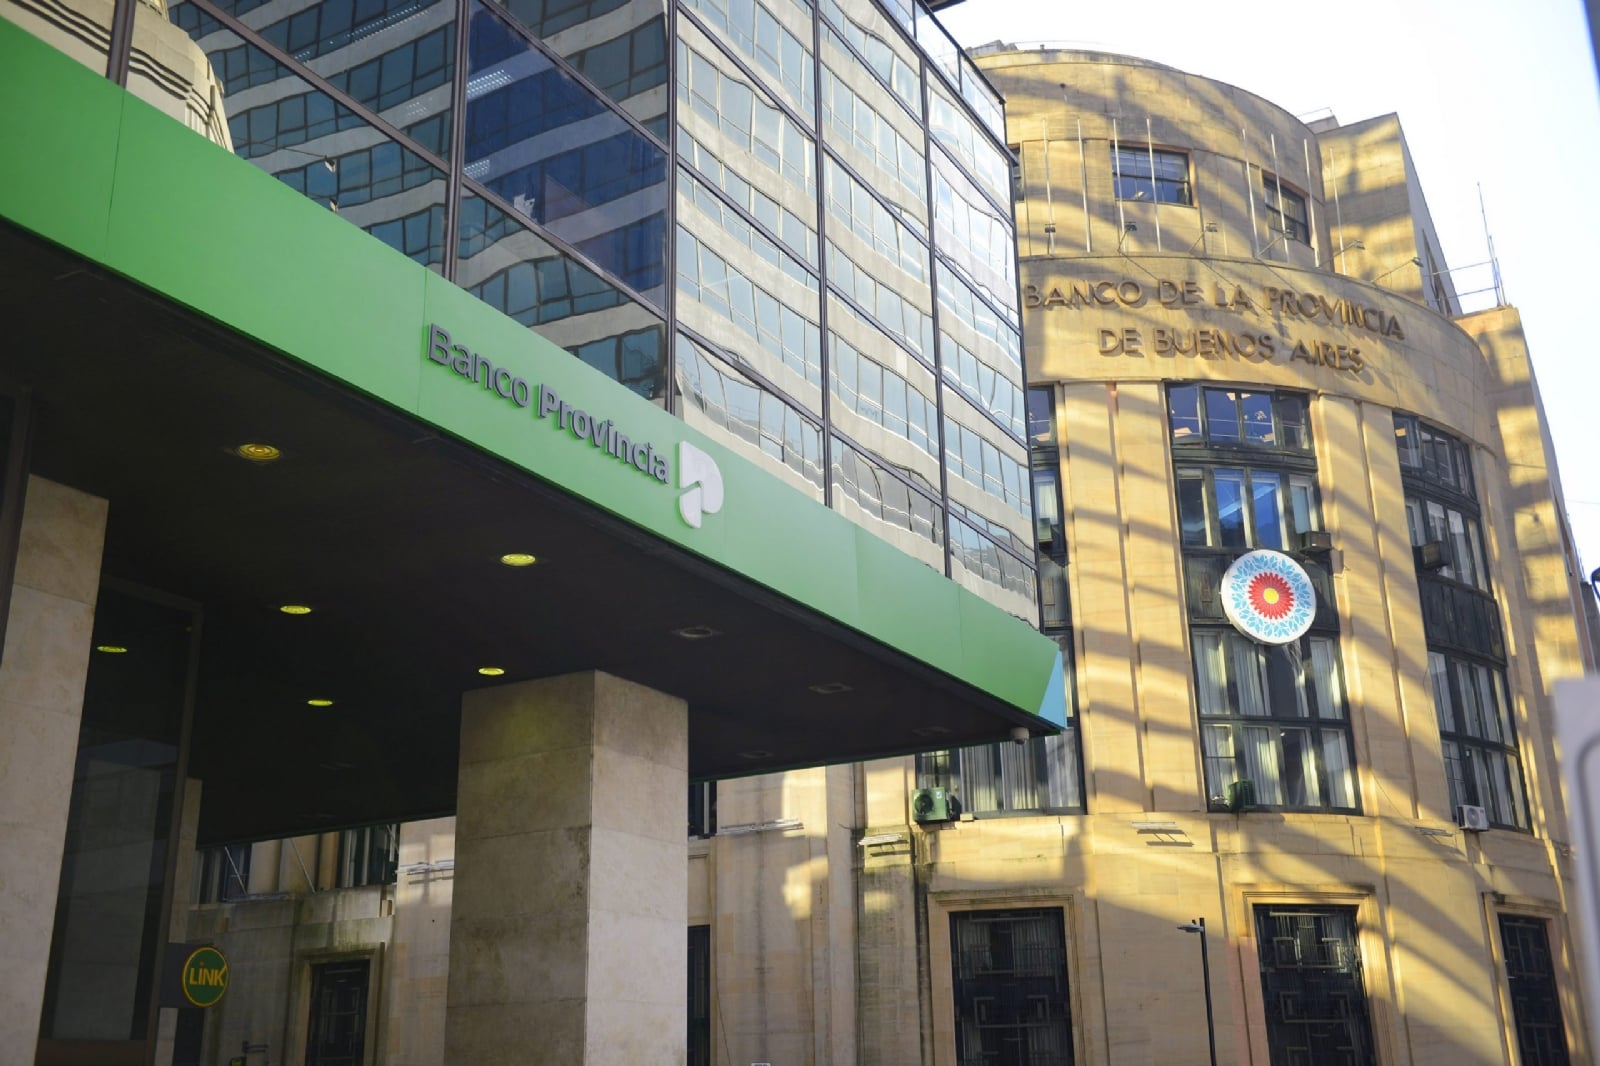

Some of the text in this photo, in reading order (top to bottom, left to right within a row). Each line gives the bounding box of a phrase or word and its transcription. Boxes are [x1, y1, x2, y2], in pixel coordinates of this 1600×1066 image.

[1024, 279, 1405, 341] BANCO DE LA PROVINCIA
[1098, 327, 1365, 374] DE BUENOS AIRES
[428, 323, 670, 484] Banco Provincia
